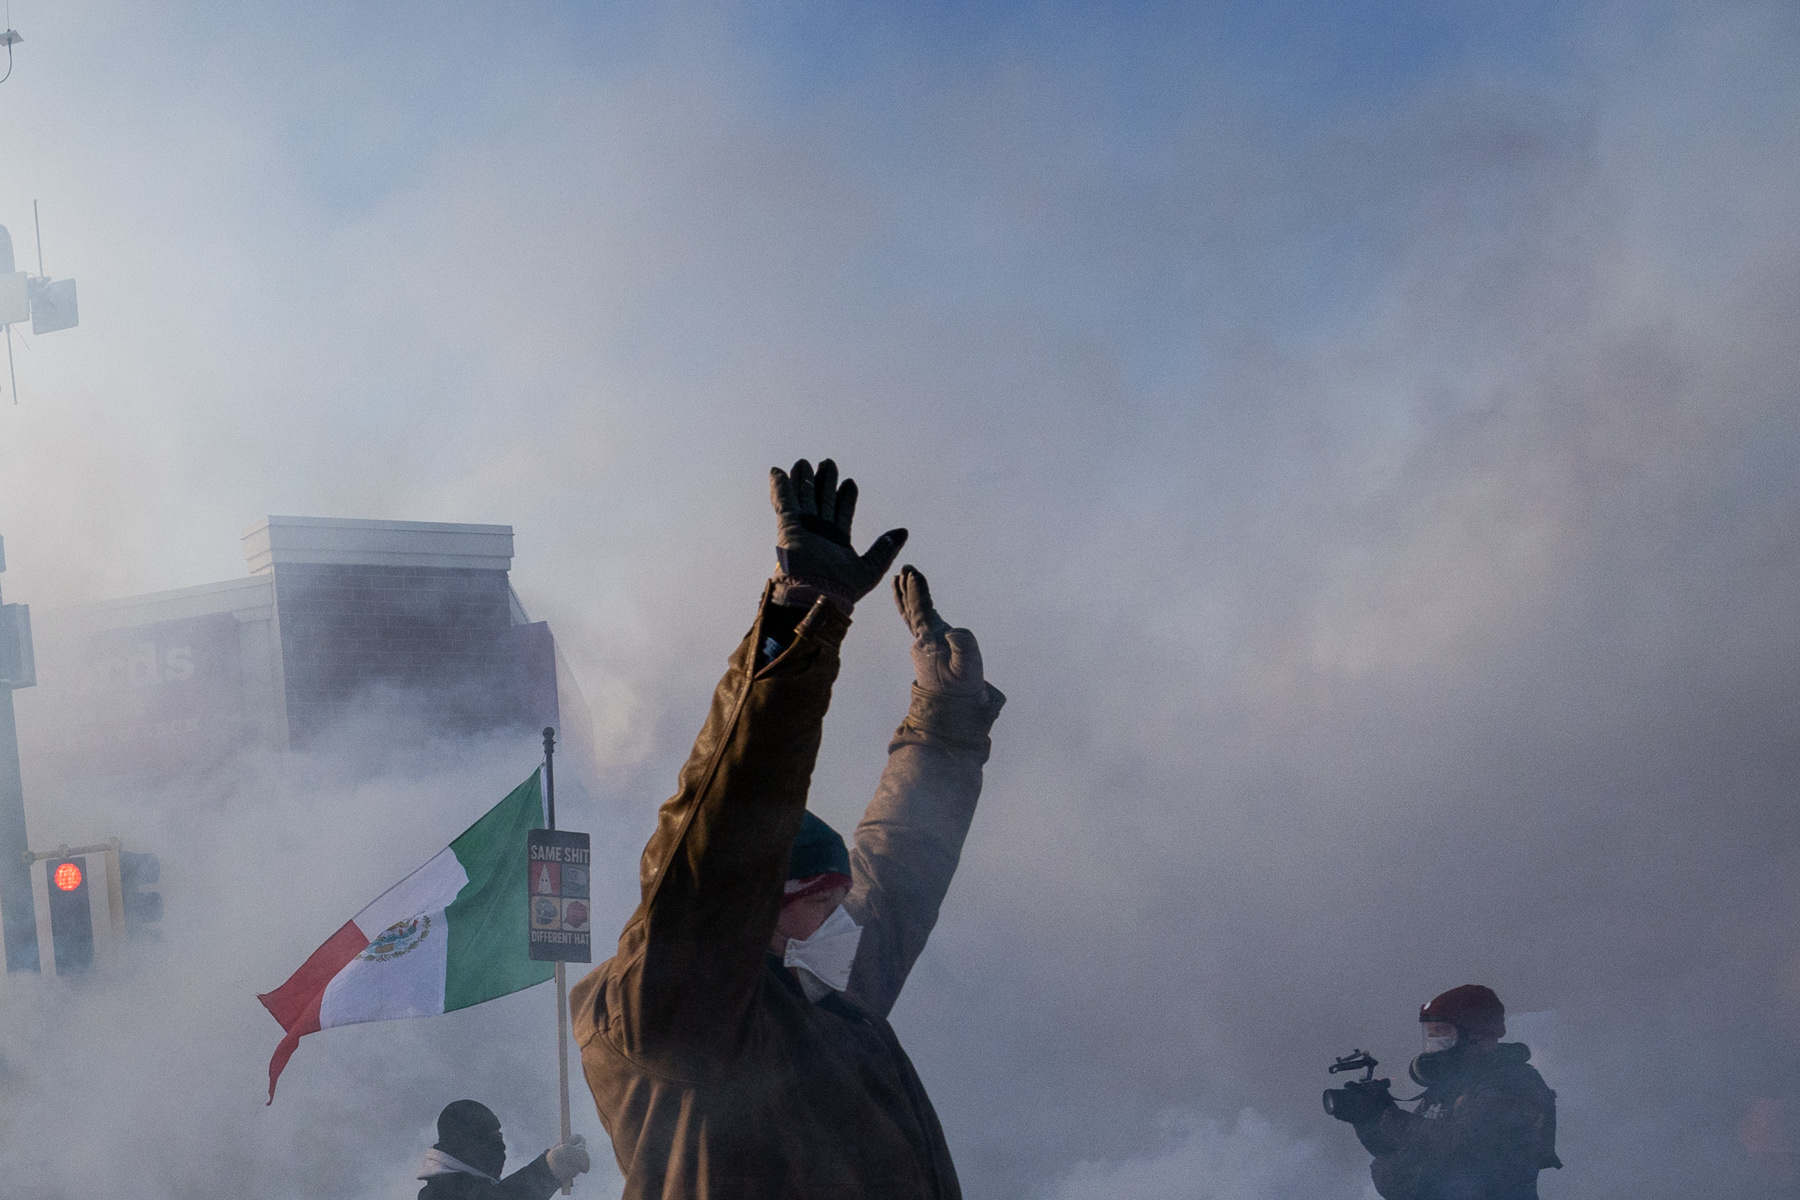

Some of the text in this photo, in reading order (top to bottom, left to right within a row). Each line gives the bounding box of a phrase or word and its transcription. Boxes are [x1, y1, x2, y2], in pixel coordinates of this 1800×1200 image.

[531, 845, 589, 864] SAME SHIT
[531, 931, 589, 945] DIFFERENT HAT
